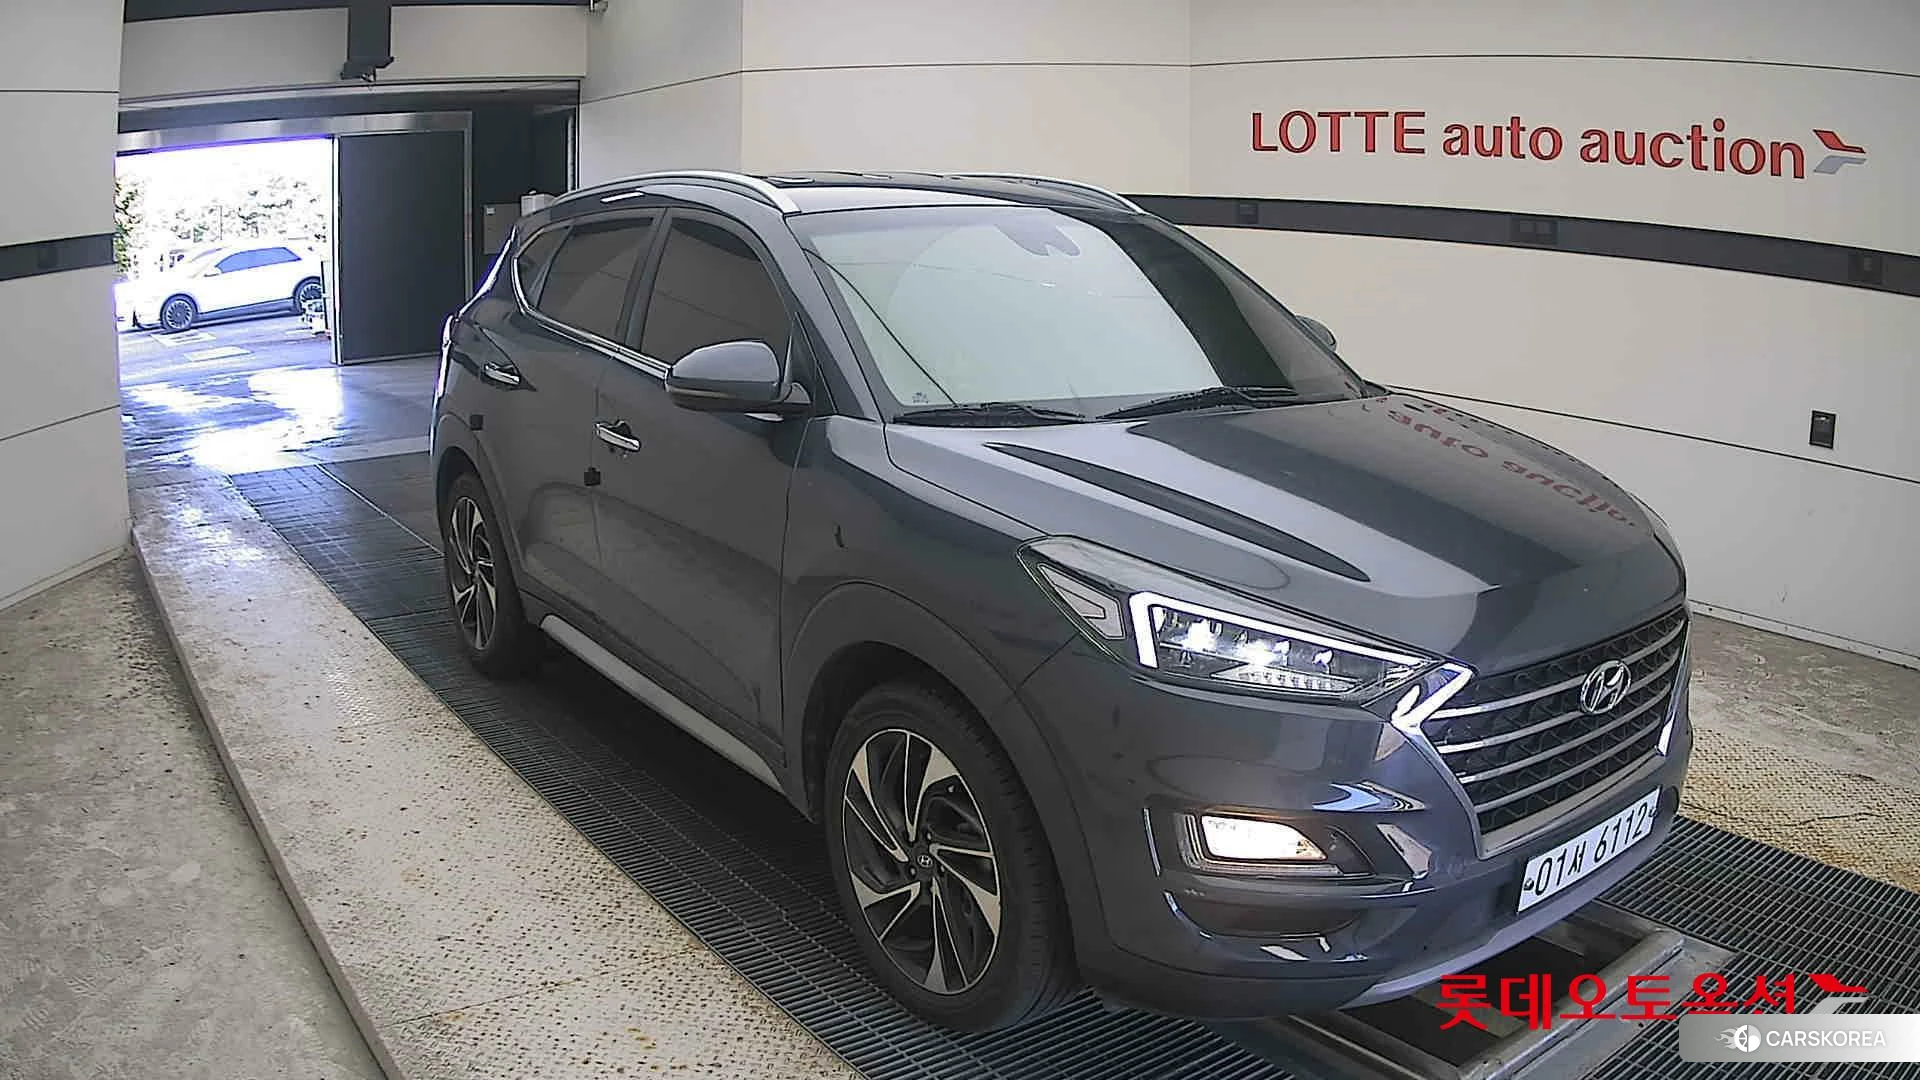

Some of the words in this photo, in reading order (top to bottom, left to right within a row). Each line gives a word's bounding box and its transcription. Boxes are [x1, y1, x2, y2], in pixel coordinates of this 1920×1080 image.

[1252, 110, 1427, 154] LOTTE
[1442, 115, 1563, 161] auto
[1579, 118, 1806, 179] auction
[1535, 840, 1587, 896] 01서
[1593, 801, 1648, 864] 6112
